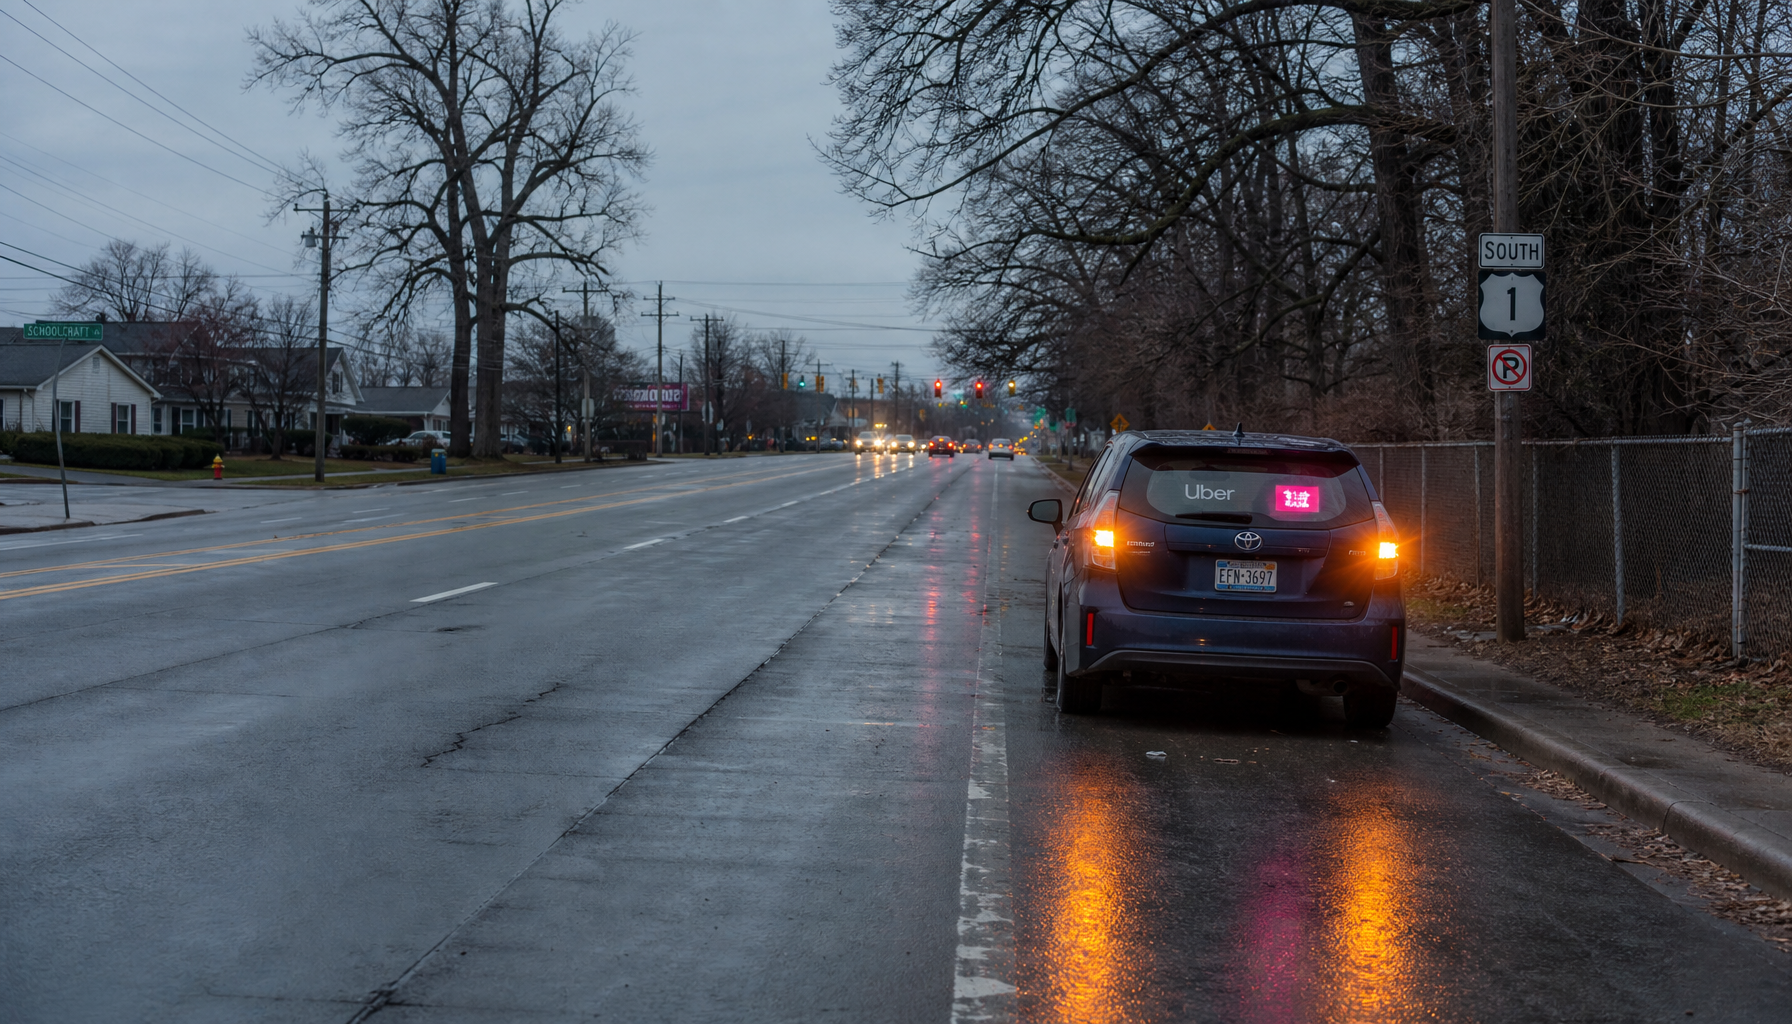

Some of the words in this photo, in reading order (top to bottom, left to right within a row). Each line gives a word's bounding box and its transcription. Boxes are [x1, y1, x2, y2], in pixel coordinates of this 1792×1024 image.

[1484, 241, 1539, 260] SOUTH
[1507, 287, 1516, 321] 1
[1185, 483, 1235, 500] Uber
